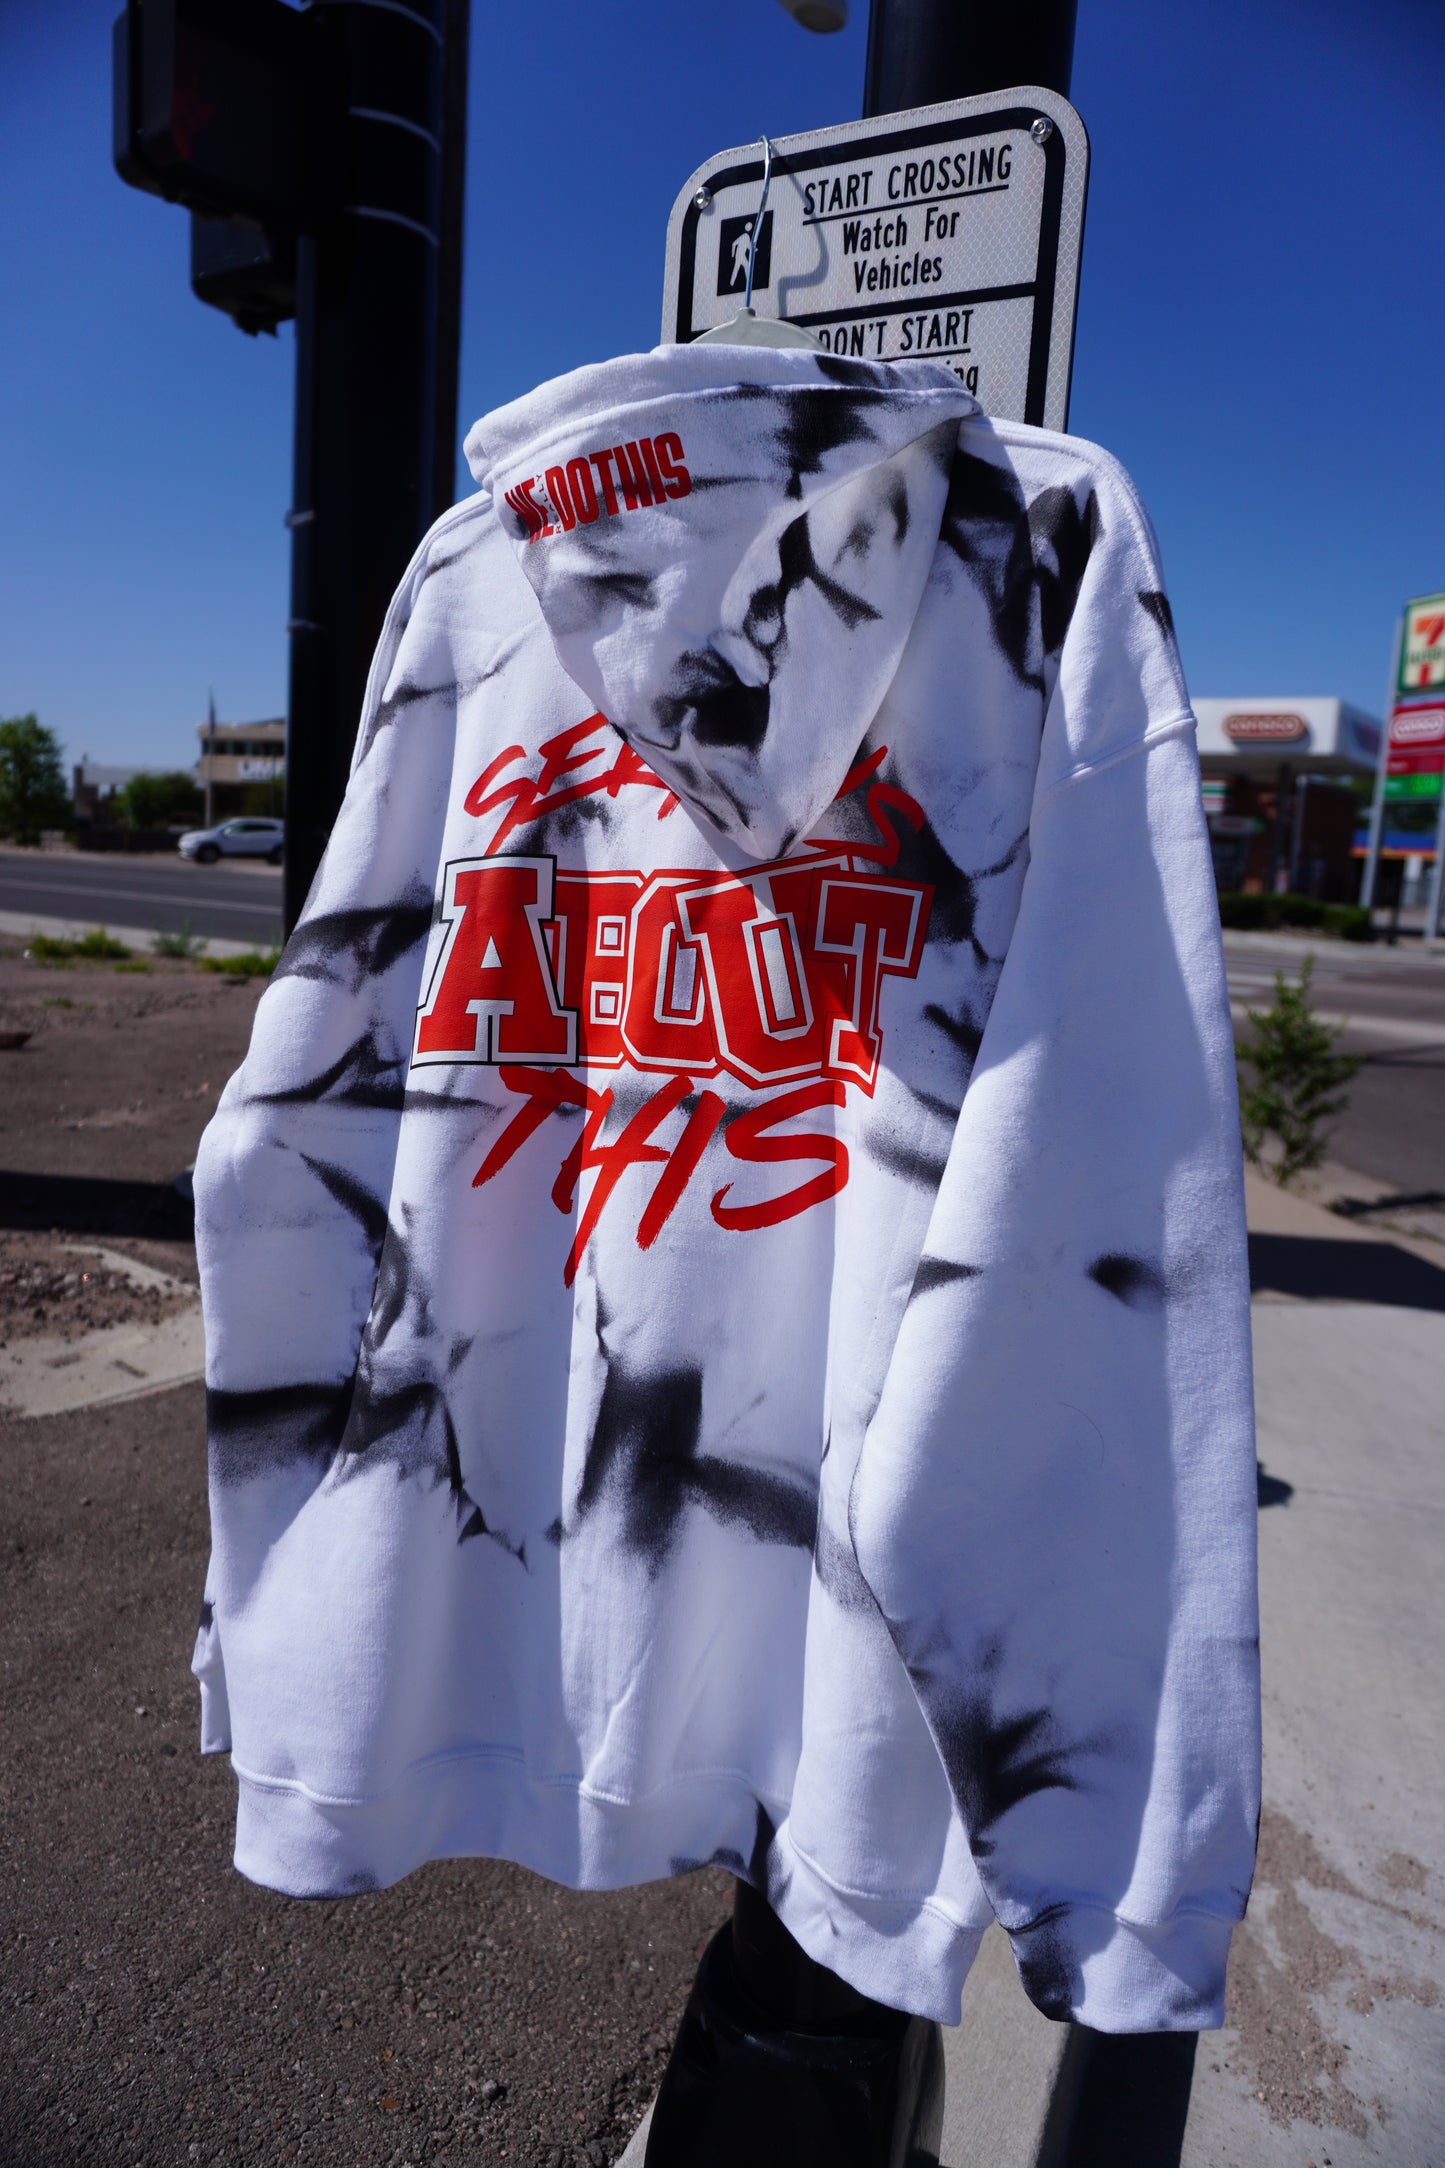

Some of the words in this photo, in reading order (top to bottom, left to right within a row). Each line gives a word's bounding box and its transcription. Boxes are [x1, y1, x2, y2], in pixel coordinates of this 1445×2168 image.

[804, 171, 872, 215] START
[888, 145, 1013, 200] CROSSING
[843, 214, 907, 255] Watch
[925, 206, 960, 242] For
[854, 252, 942, 294] Vehicles
[900, 309, 974, 351] START
[411, 847, 936, 1098] ABOUT
[472, 1066, 849, 1289] THIS
